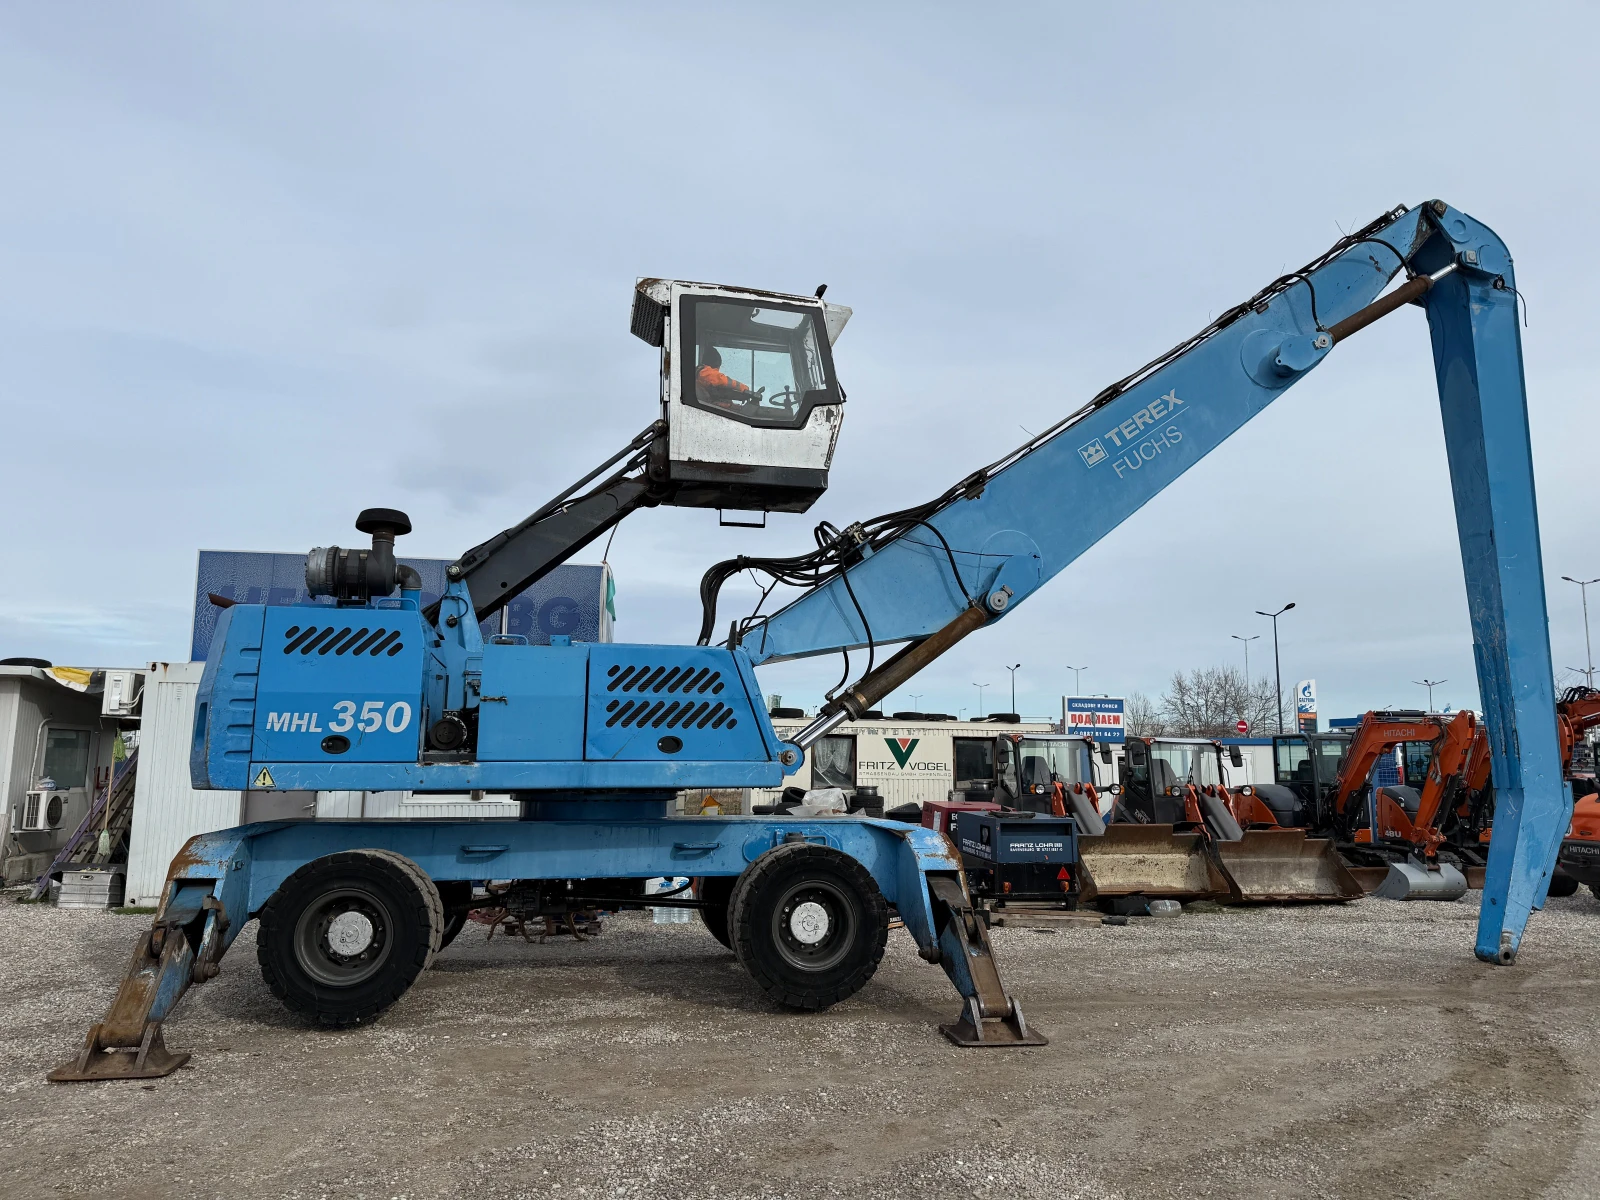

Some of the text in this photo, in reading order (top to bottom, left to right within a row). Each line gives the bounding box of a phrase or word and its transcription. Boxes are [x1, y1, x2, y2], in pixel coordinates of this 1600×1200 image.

[1104, 388, 1184, 447] TEREX
[1112, 425, 1183, 479] FUCHS
[265, 700, 412, 733] MHL 350
[1383, 728, 1415, 737] HITACHI
[858, 761, 951, 771] FRITZ VOGEL
[1569, 845, 1600, 855] HITACHI
